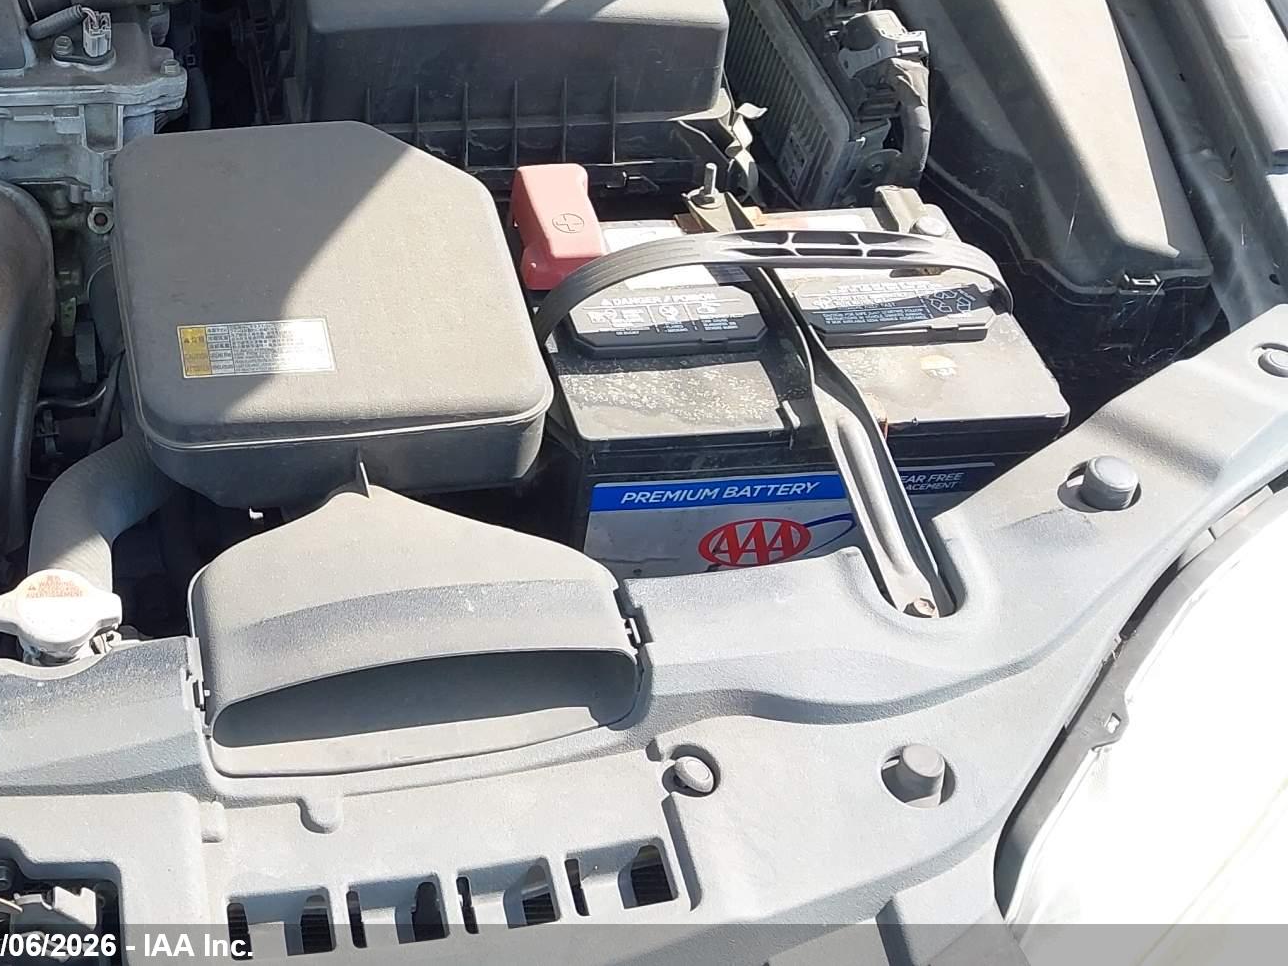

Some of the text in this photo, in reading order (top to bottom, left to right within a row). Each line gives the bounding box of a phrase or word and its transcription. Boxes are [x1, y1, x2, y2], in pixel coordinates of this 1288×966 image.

[900, 472, 965, 484] EAR FREE
[905, 481, 958, 491] ACEMENT
[620, 481, 821, 505] PREMIUM BATTERY
[706, 520, 803, 566] AAA
